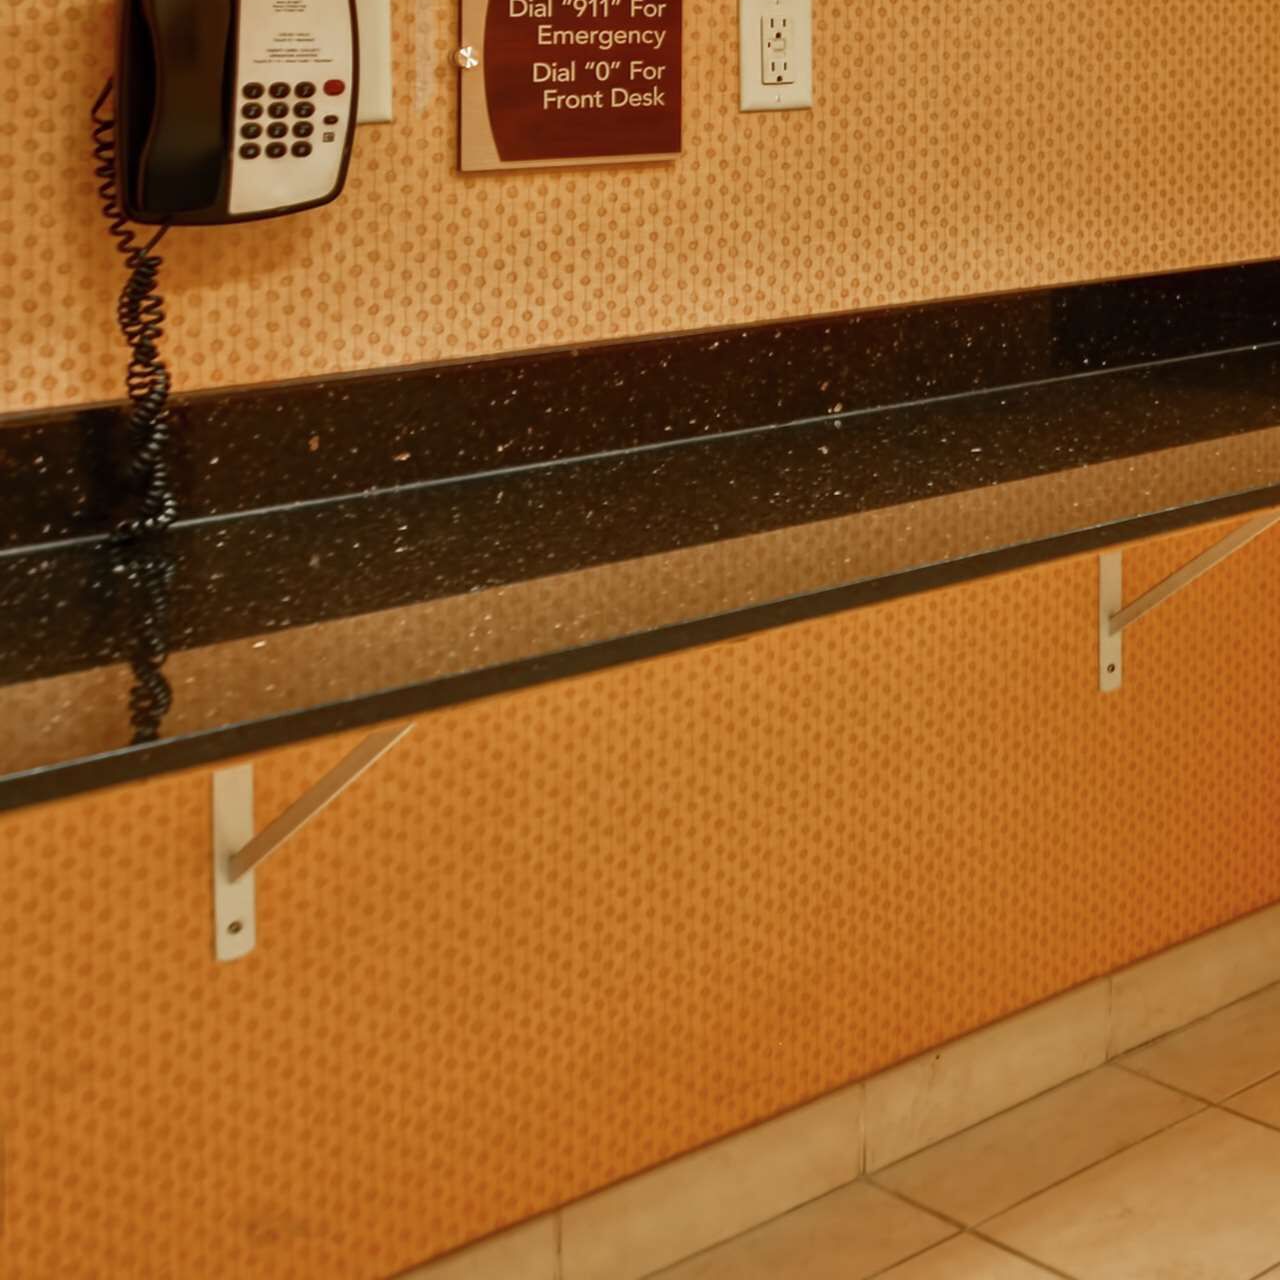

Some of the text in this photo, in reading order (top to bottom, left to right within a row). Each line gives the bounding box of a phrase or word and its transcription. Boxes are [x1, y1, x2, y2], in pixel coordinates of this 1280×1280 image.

[631, 0, 666, 17] For
[538, 25, 666, 49] Emergency
[533, 62, 575, 82] Dial
[630, 61, 665, 79] For
[543, 86, 664, 109] Front Desk
